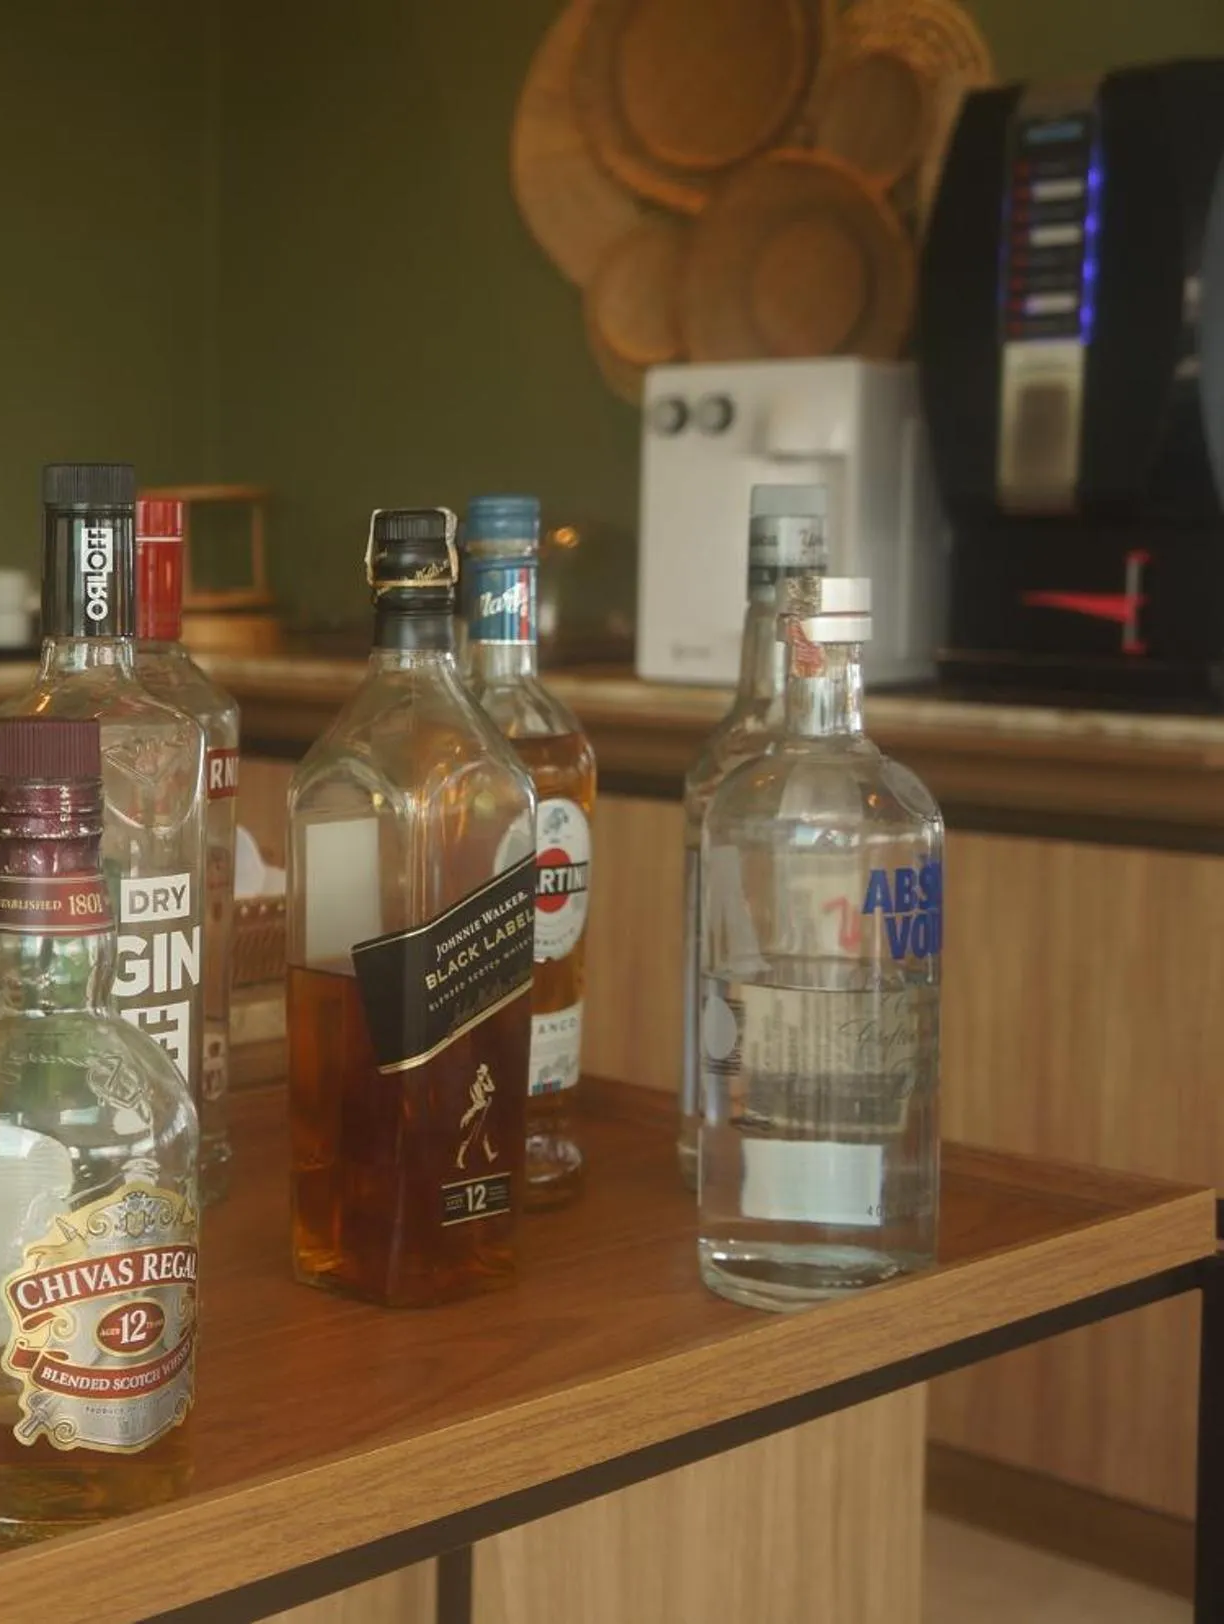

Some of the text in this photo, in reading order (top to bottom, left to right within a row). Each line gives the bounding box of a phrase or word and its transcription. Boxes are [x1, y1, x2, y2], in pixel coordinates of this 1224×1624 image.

[84, 529, 109, 621] ORLOFF
[68, 893, 103, 916] 1801
[128, 884, 187, 915] DRY
[425, 943, 481, 991] BLACK
[483, 907, 536, 951] LABEL
[436, 891, 529, 962] JOHNNIE WALKER
[111, 925, 201, 997] GIN
[466, 1184, 487, 1212] 12
[16, 1250, 197, 1311] CHIVAS REGAL
[119, 1309, 148, 1345] 12
[41, 1366, 111, 1391] BLENDED
[112, 1367, 161, 1391] SCOTCH
